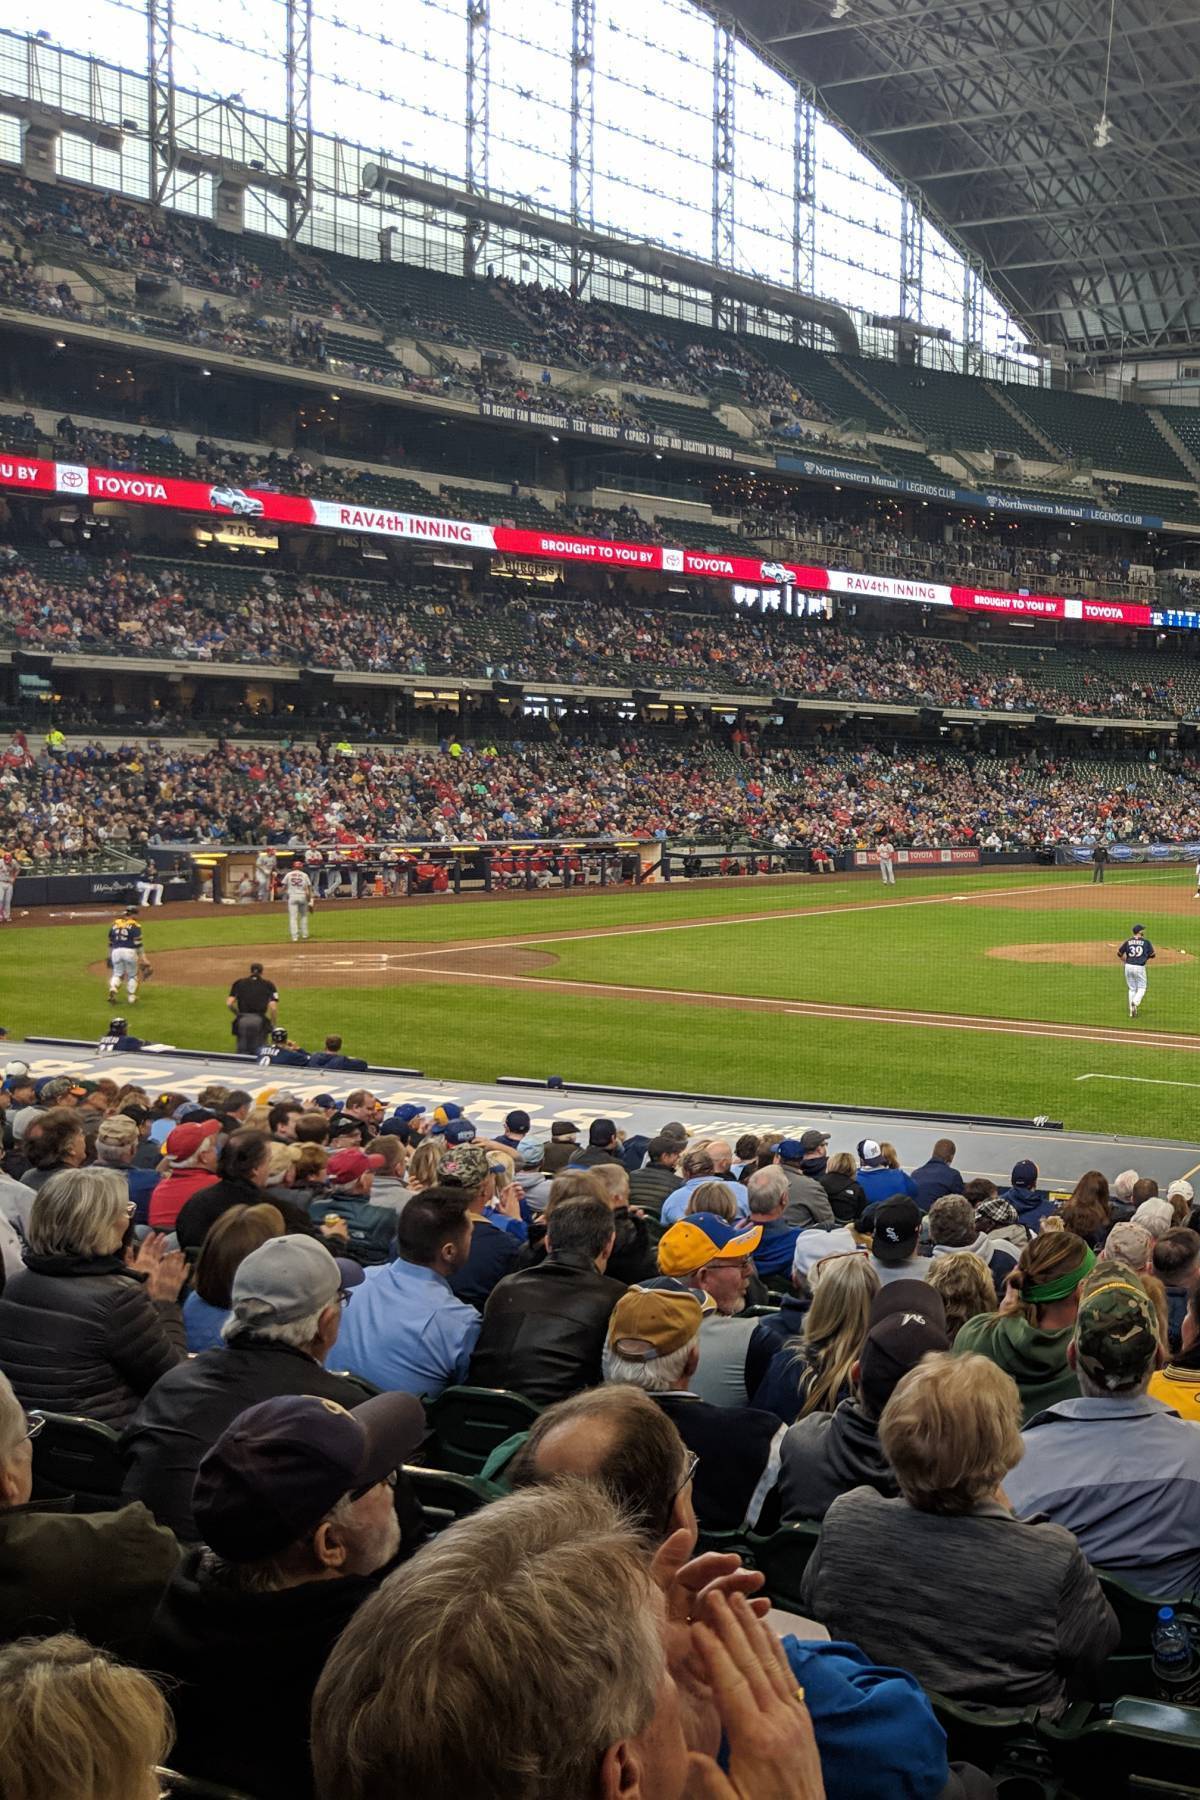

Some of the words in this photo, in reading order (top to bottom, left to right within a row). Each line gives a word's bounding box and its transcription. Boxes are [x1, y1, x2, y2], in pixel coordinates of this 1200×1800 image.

[492, 404, 515, 420] REPORT
[572, 419, 587, 432] TEXT
[18, 466, 39, 481] BY
[815, 464, 870, 484] Northwestern
[871, 474, 899, 489] Mutual
[906, 480, 938, 497] LEGENDS
[938, 485, 956, 500] CLUB
[95, 475, 168, 500] TOYOTA
[998, 498, 1054, 514] Northwestern
[1054, 505, 1083, 518] Mutual
[1090, 510, 1123, 523] LEGENDS
[1123, 514, 1143, 525] CLUB
[340, 508, 404, 532] RAV4th
[409, 518, 472, 542] INNING
[540, 539, 596, 556] BROUGHT
[597, 547, 613, 558] TO
[615, 549, 638, 561] YOU
[640, 552, 653, 563] BY
[505, 561, 554, 576] BURGERS
[687, 555, 734, 574] TOYOTA
[846, 576, 890, 595] RAV4th
[893, 582, 936, 599] INNING
[974, 594, 1011, 609] BROUGHT
[1012, 599, 1025, 610] TO
[1025, 600, 1044, 611] YOU
[1085, 605, 1123, 618] TOYOTA
[291, 878, 303, 887] 52
[1128, 946, 1144, 957] 39
